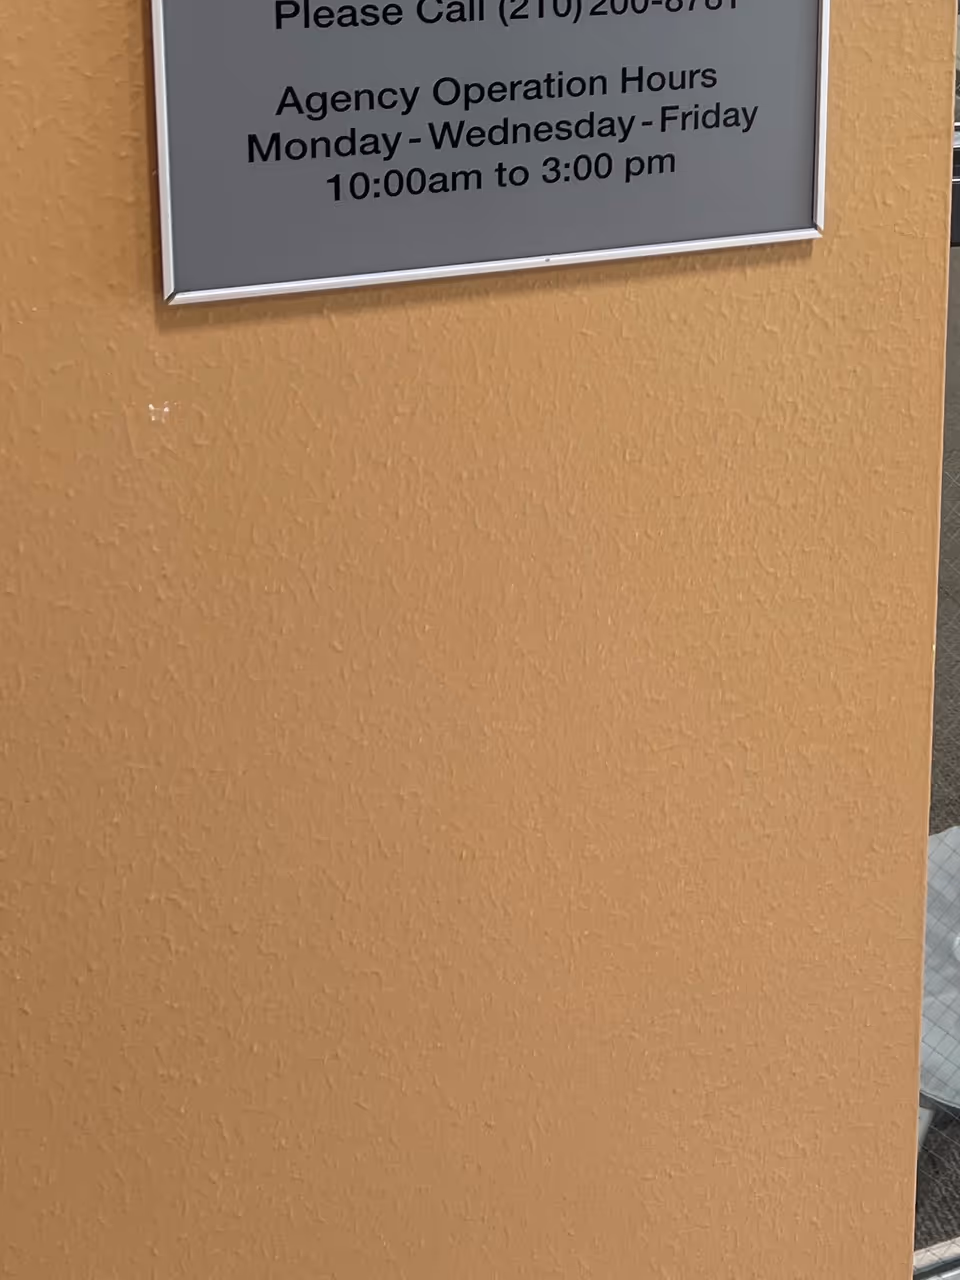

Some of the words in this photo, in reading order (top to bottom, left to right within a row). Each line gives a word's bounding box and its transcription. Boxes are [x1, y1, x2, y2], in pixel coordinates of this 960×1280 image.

[275, 0, 403, 29] Please
[275, 86, 420, 121] Agency
[433, 71, 607, 111] Operation
[622, 66, 717, 93] Hours
[327, 168, 481, 201] 10:00am
[495, 163, 529, 187] to
[542, 153, 612, 183] 3:00
[625, 154, 675, 183] pm
